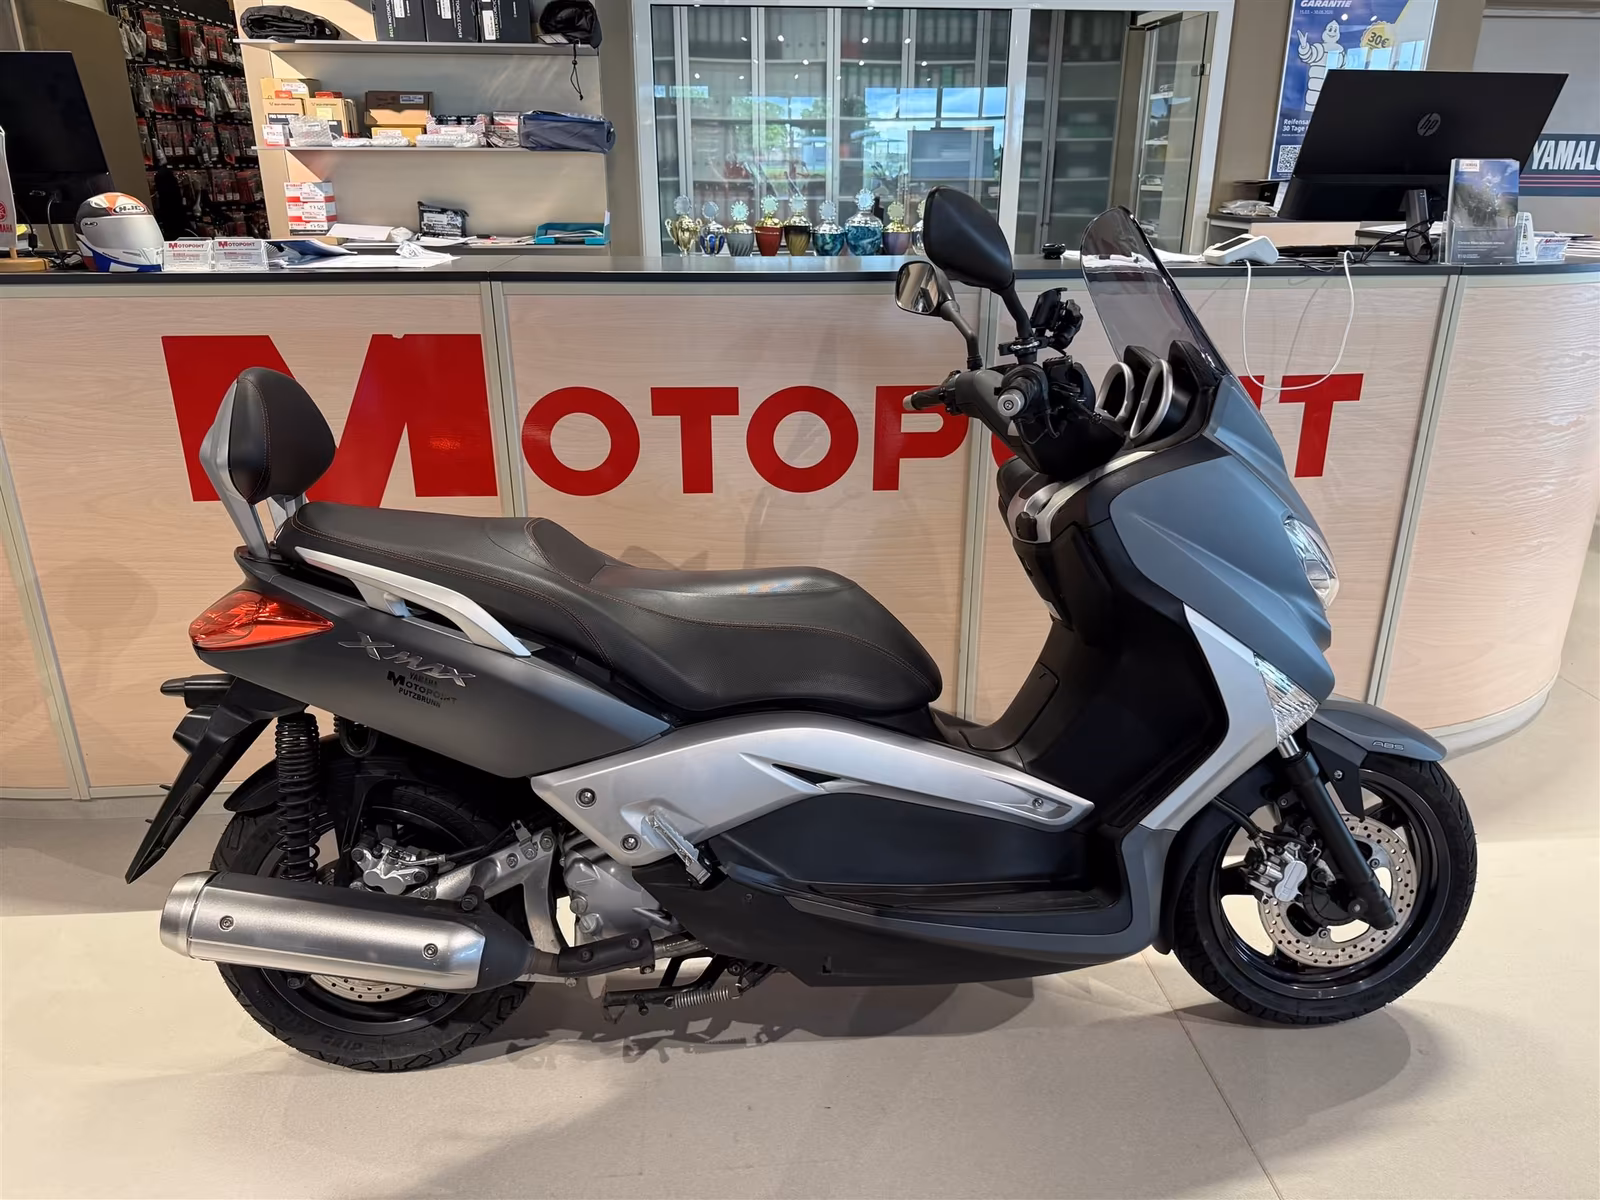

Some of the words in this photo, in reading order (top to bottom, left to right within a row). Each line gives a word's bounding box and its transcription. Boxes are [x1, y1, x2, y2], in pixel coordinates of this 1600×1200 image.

[1300, 0, 1352, 8] GARANTIE
[1367, 31, 1390, 48] 30€
[1417, 112, 1441, 137] hp
[161, 333, 1364, 508] MOTOPT
[398, 687, 442, 709] PUTZBRUNN
[1372, 740, 1404, 751] ABS
